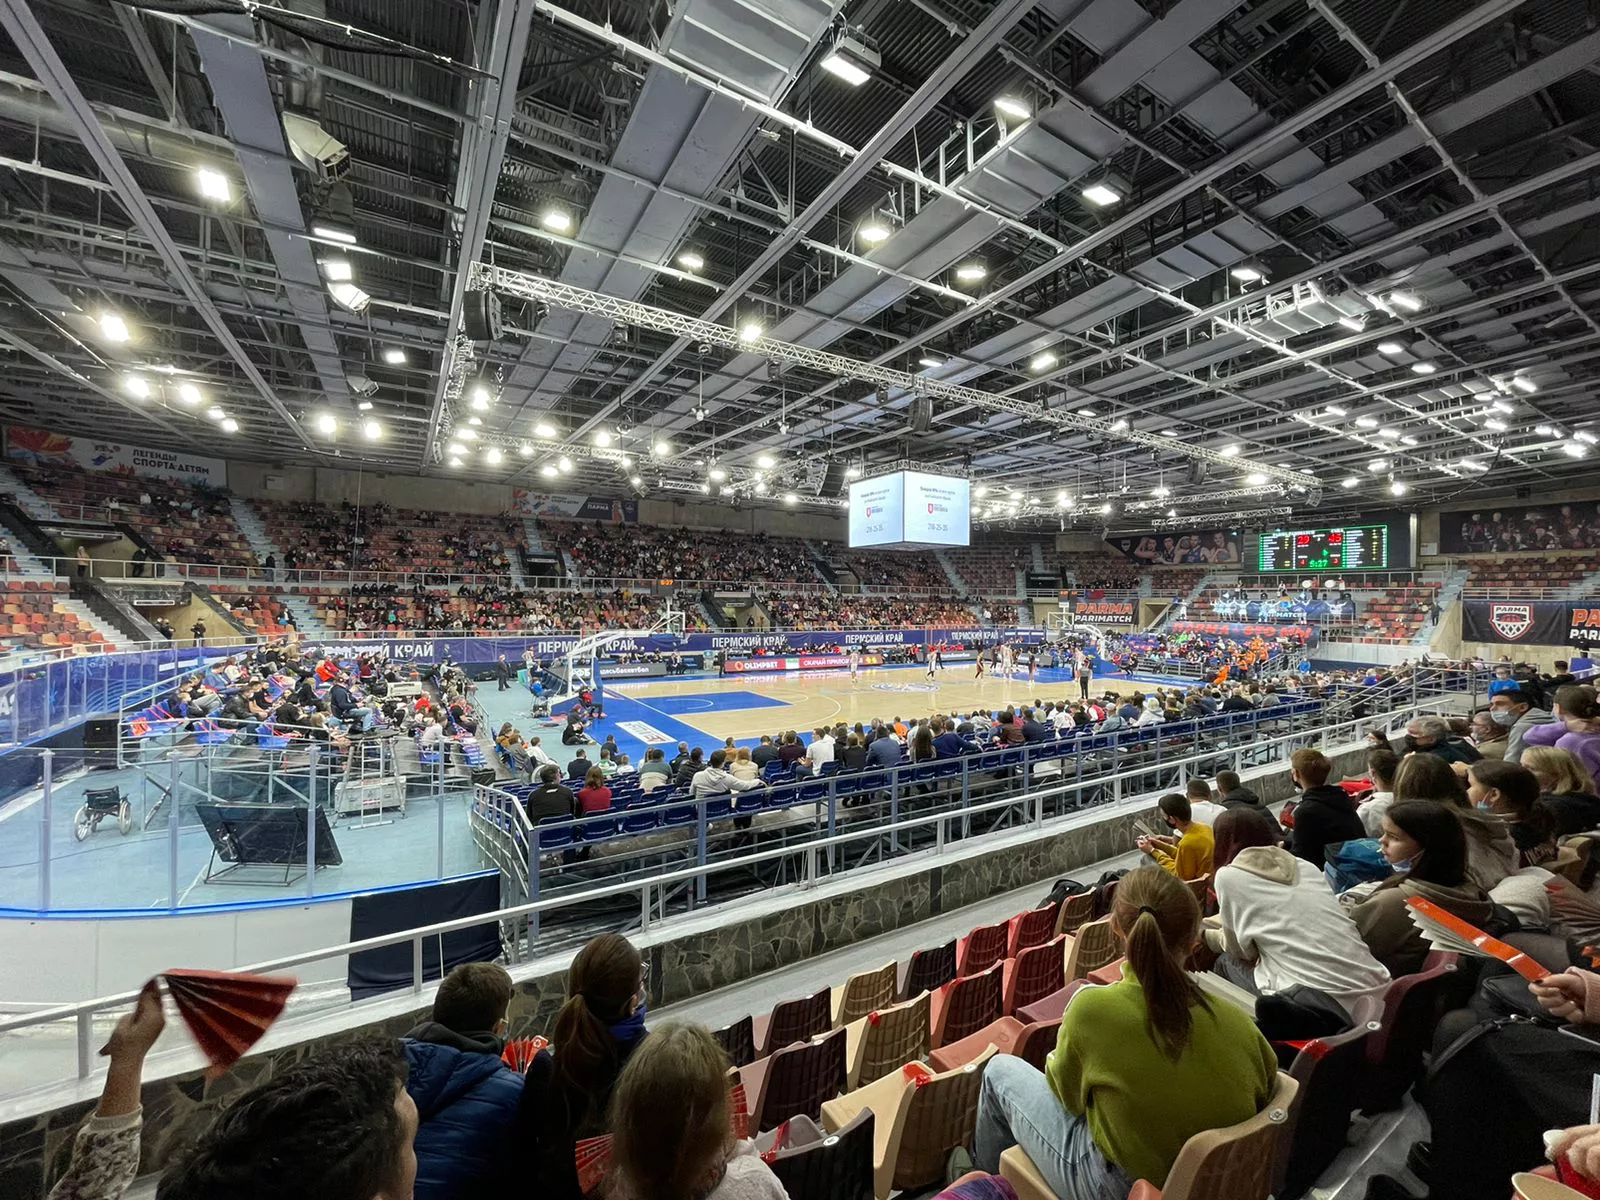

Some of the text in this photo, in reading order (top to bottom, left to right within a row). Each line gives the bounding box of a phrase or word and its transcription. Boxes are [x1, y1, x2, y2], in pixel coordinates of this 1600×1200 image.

[132, 449, 177, 462] ЛЕГЕНДЫ
[1309, 559, 1328, 567] 5:27
[1075, 602, 1133, 615] PARMA
[1074, 614, 1132, 623] PARIMATCH
[712, 634, 762, 648] ПЕРМСКИЙ
[845, 632, 904, 644] ПЕРМСКИЙ КРАЙ
[394, 641, 433, 658] КРАЙ
[605, 637, 634, 653] КРАЙ
